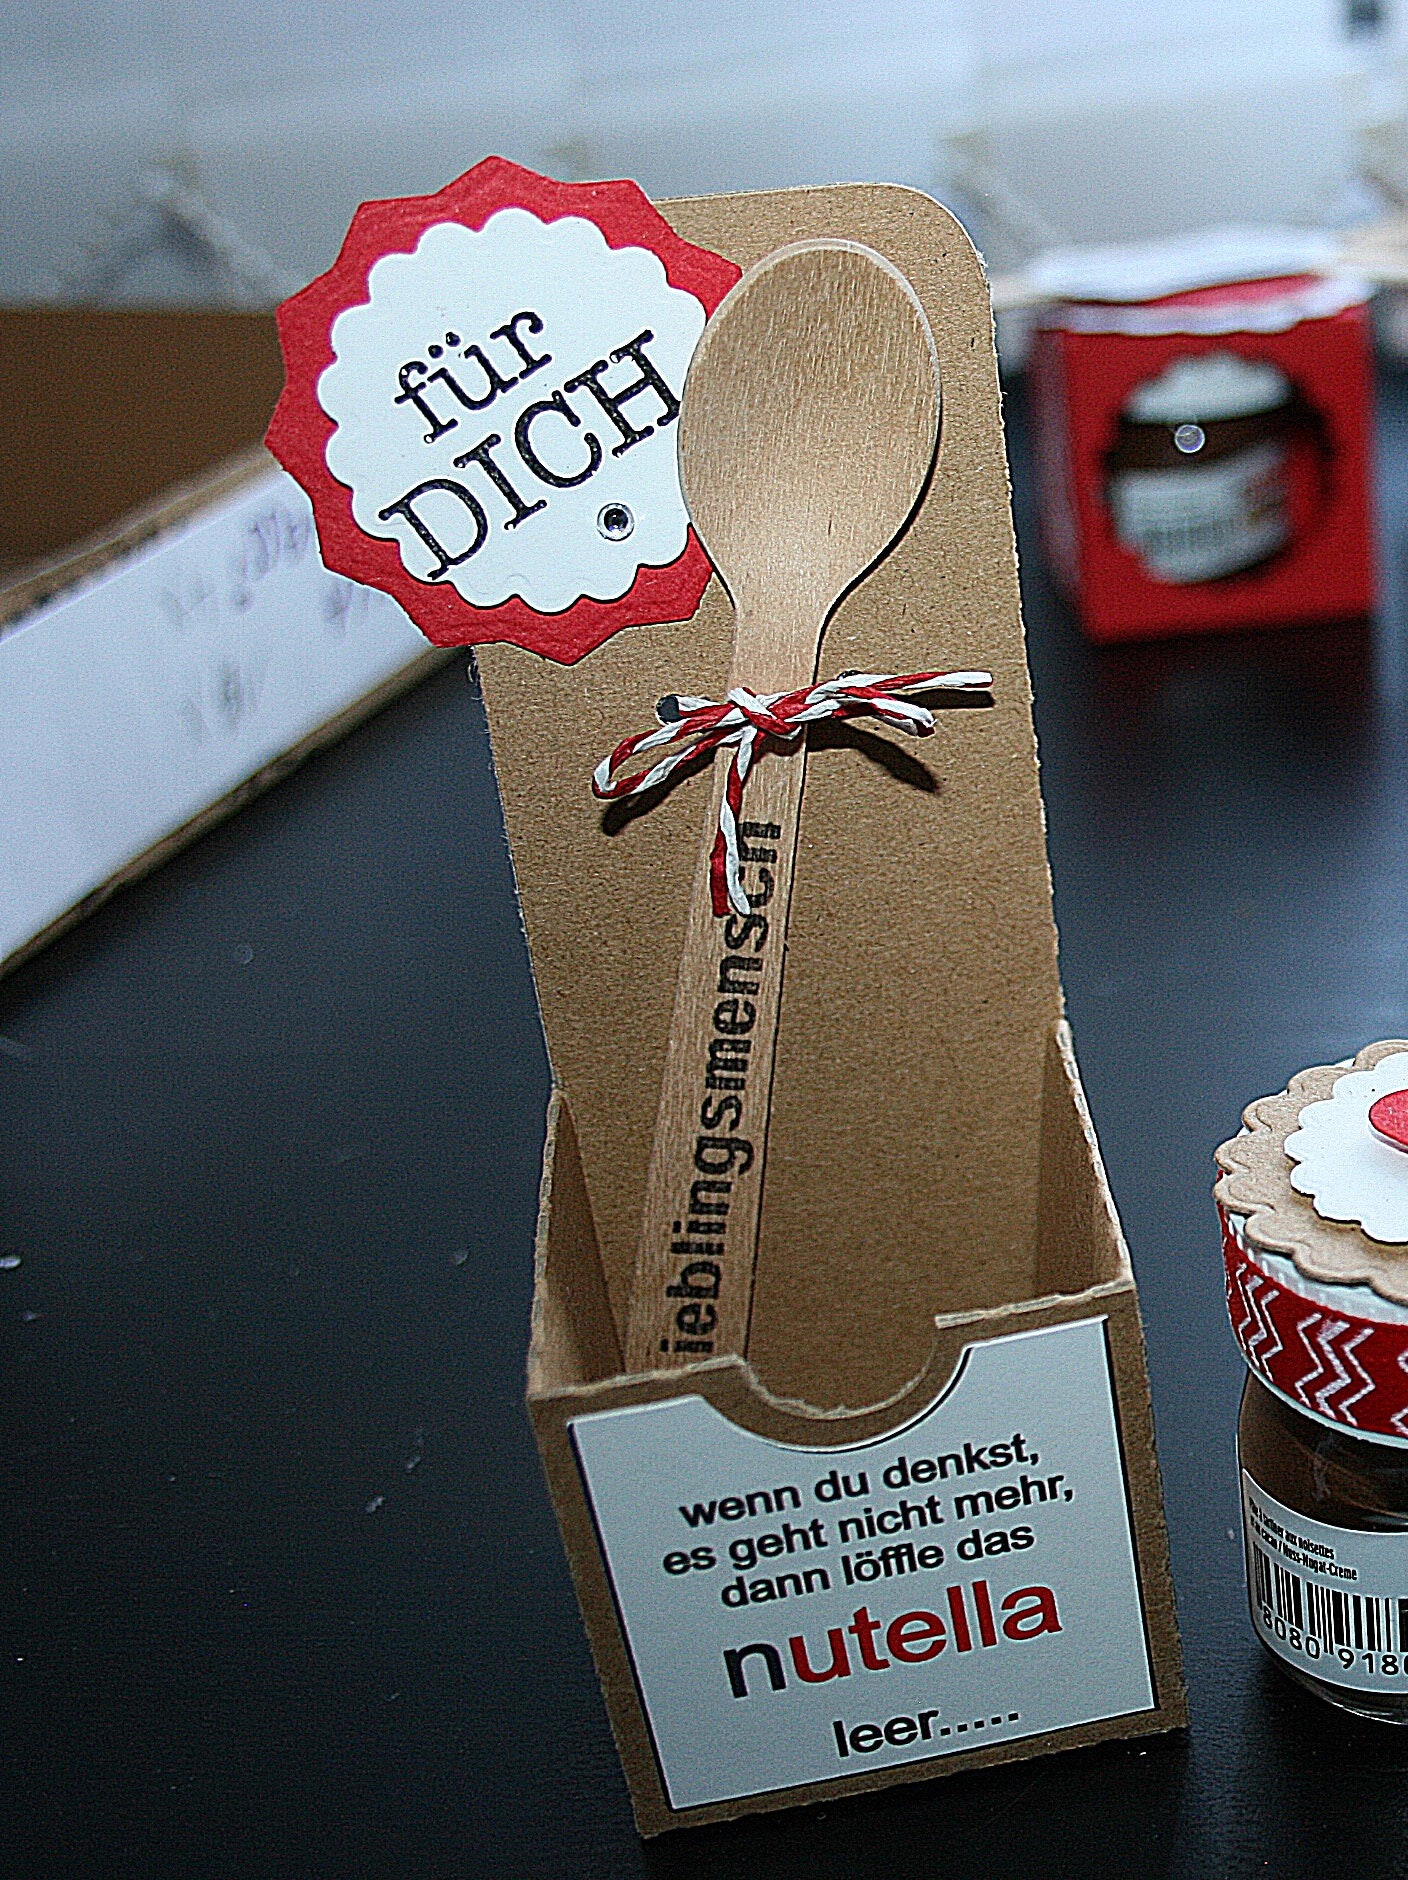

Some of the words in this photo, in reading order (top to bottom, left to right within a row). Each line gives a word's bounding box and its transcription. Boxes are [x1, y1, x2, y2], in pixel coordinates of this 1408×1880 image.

[395, 311, 552, 444] für
[378, 330, 682, 579] DICH
[662, 1546, 717, 1575] es
[728, 1517, 829, 1571] geht
[838, 1495, 944, 1547] nicht
[955, 1470, 1075, 1521] mehr,
[679, 1483, 802, 1528] wenn
[813, 1468, 870, 1503] du
[881, 1432, 1040, 1491] denkst,
[720, 1565, 831, 1609] dann
[843, 1541, 945, 1586] löffle
[956, 1524, 1036, 1562] das
[723, 1579, 1064, 1699] nutella
[1262, 1606, 1321, 1660] 8080
[831, 1706, 1020, 1759] leer.....
